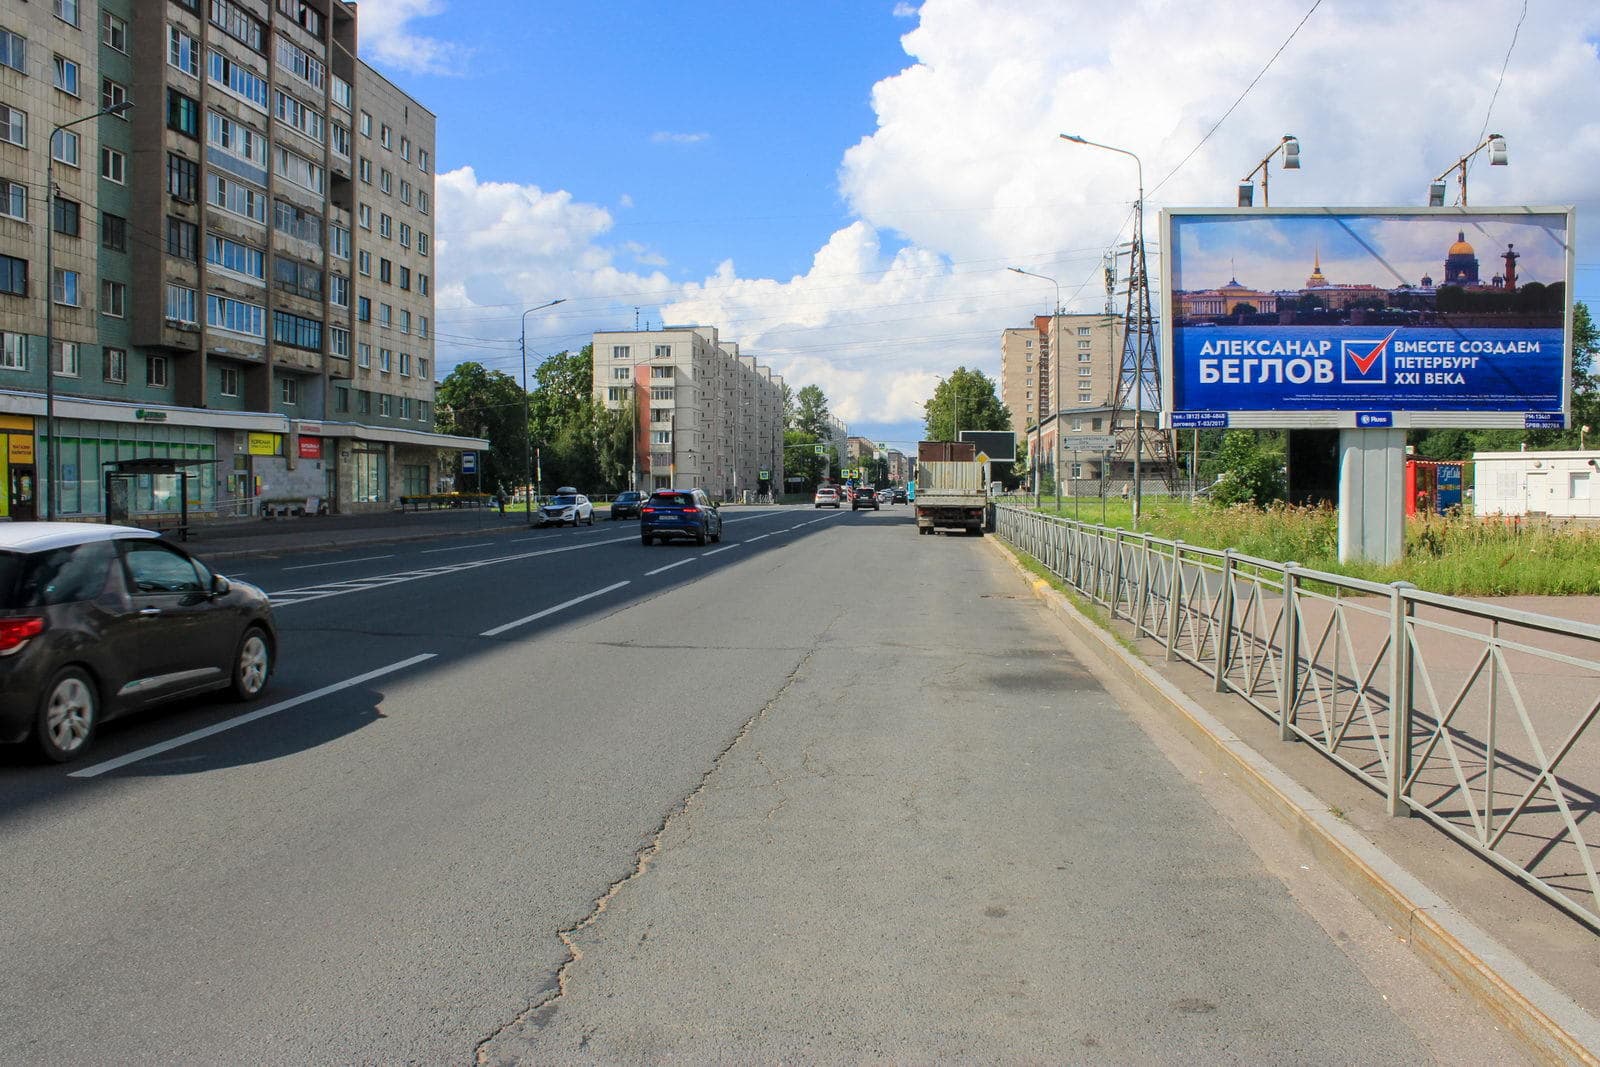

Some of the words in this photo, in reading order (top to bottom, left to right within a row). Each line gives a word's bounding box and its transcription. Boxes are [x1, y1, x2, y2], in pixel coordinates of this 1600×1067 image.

[1200, 340, 1331, 357] АЛЕКСАНДР
[1394, 341, 1455, 353] ВМЕСТЕ
[1460, 341, 1540, 354] СОЗДАЕМ
[1394, 356, 1479, 368] ПЕТЕРБУРГ
[1200, 359, 1334, 384] БЕГЛОВ
[1394, 373, 1419, 384] XXI
[1425, 373, 1465, 384] ВЕКА
